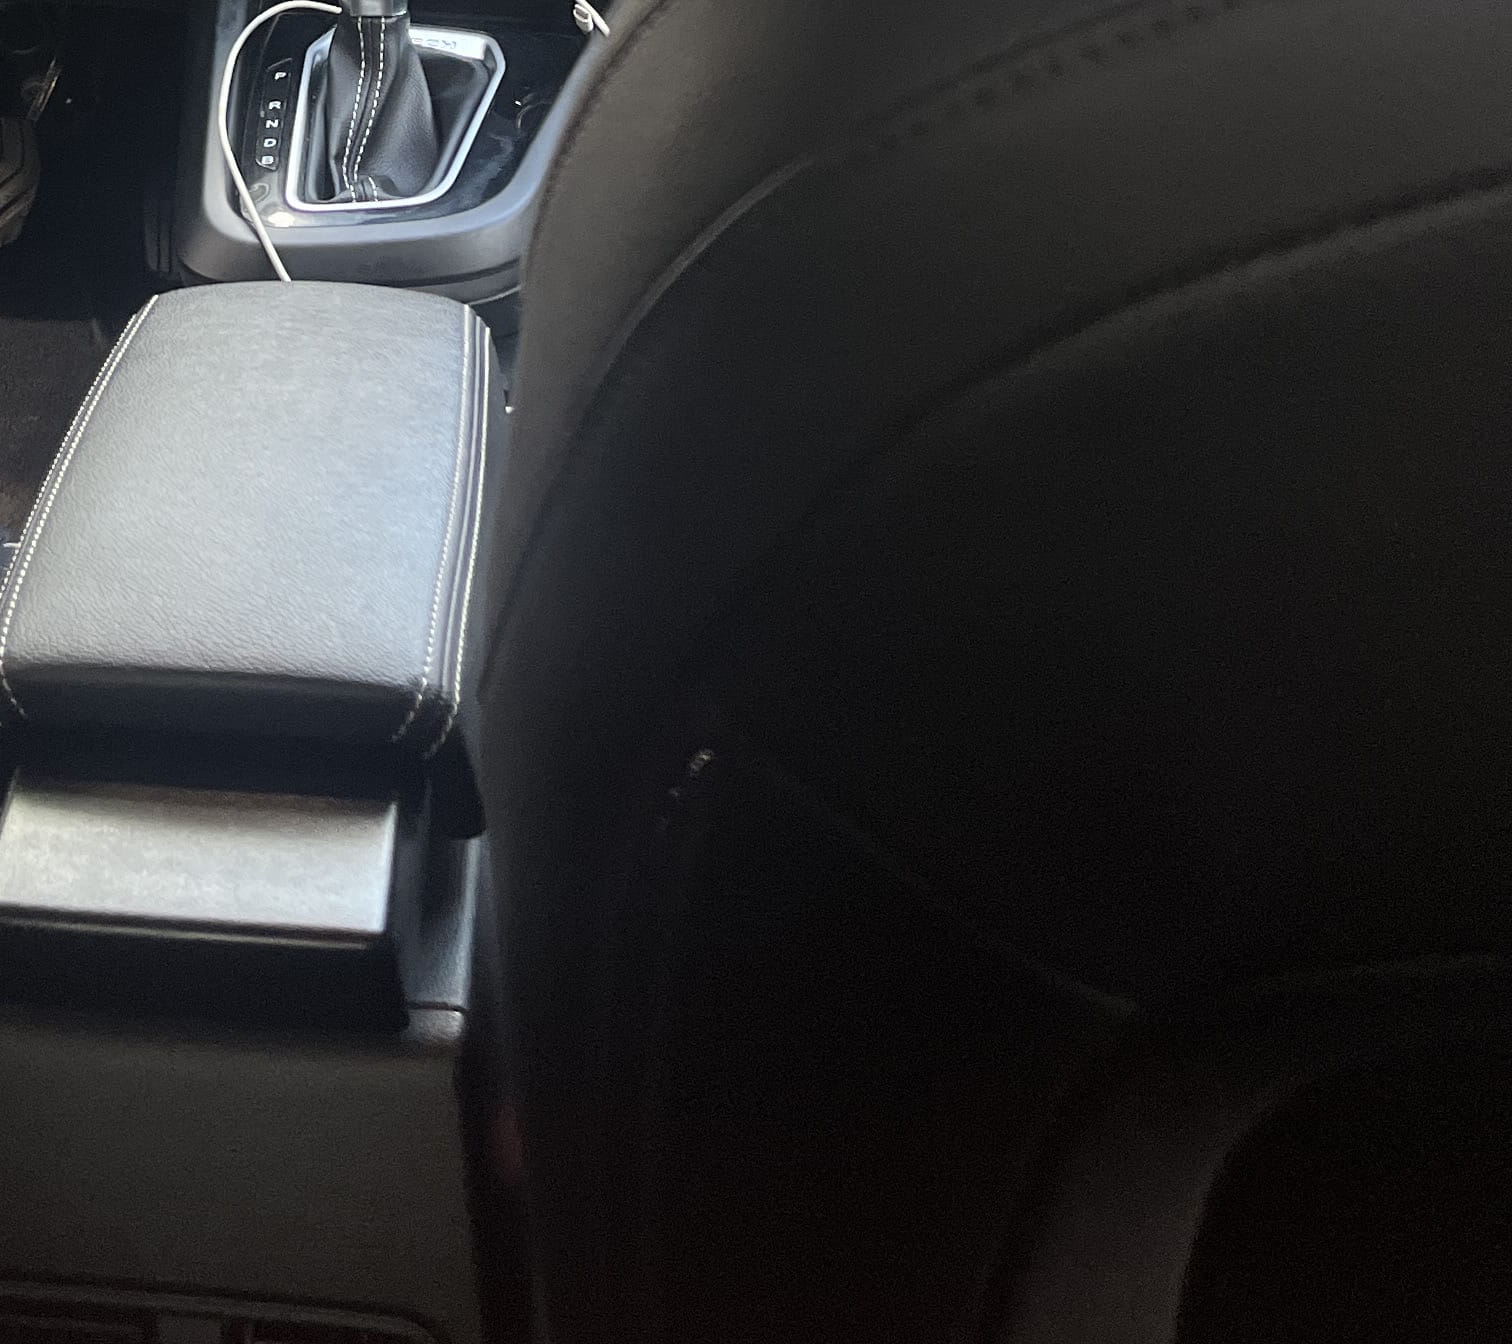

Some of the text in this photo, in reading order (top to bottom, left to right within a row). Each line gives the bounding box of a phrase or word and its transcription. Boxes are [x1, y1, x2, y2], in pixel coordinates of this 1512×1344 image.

[274, 72, 287, 80] P
[268, 100, 282, 110] R
[265, 119, 279, 129] N
[263, 138, 277, 148] D
